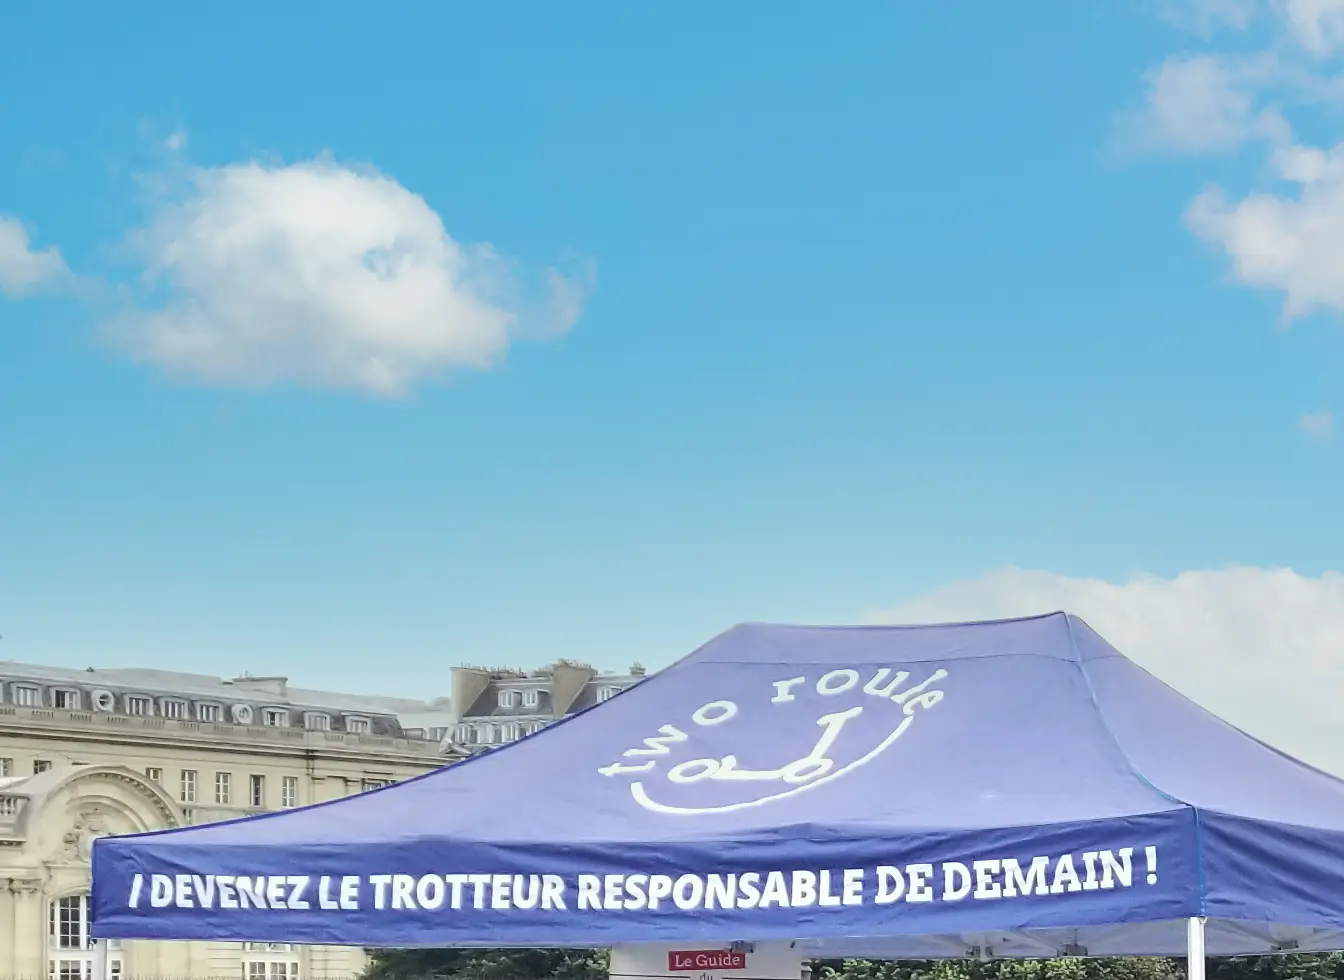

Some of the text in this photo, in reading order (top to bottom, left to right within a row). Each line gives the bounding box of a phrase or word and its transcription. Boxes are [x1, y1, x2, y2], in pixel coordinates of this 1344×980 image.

[598, 668, 949, 776] two roule
[150, 874, 311, 910] DEVENEZ
[318, 875, 360, 910] LE
[369, 873, 567, 910] TROTTEUR
[577, 868, 864, 910] RESPONSABLE
[874, 863, 934, 905] DE
[941, 847, 1133, 902] DEMAIN
[674, 953, 741, 968] Le Guide
